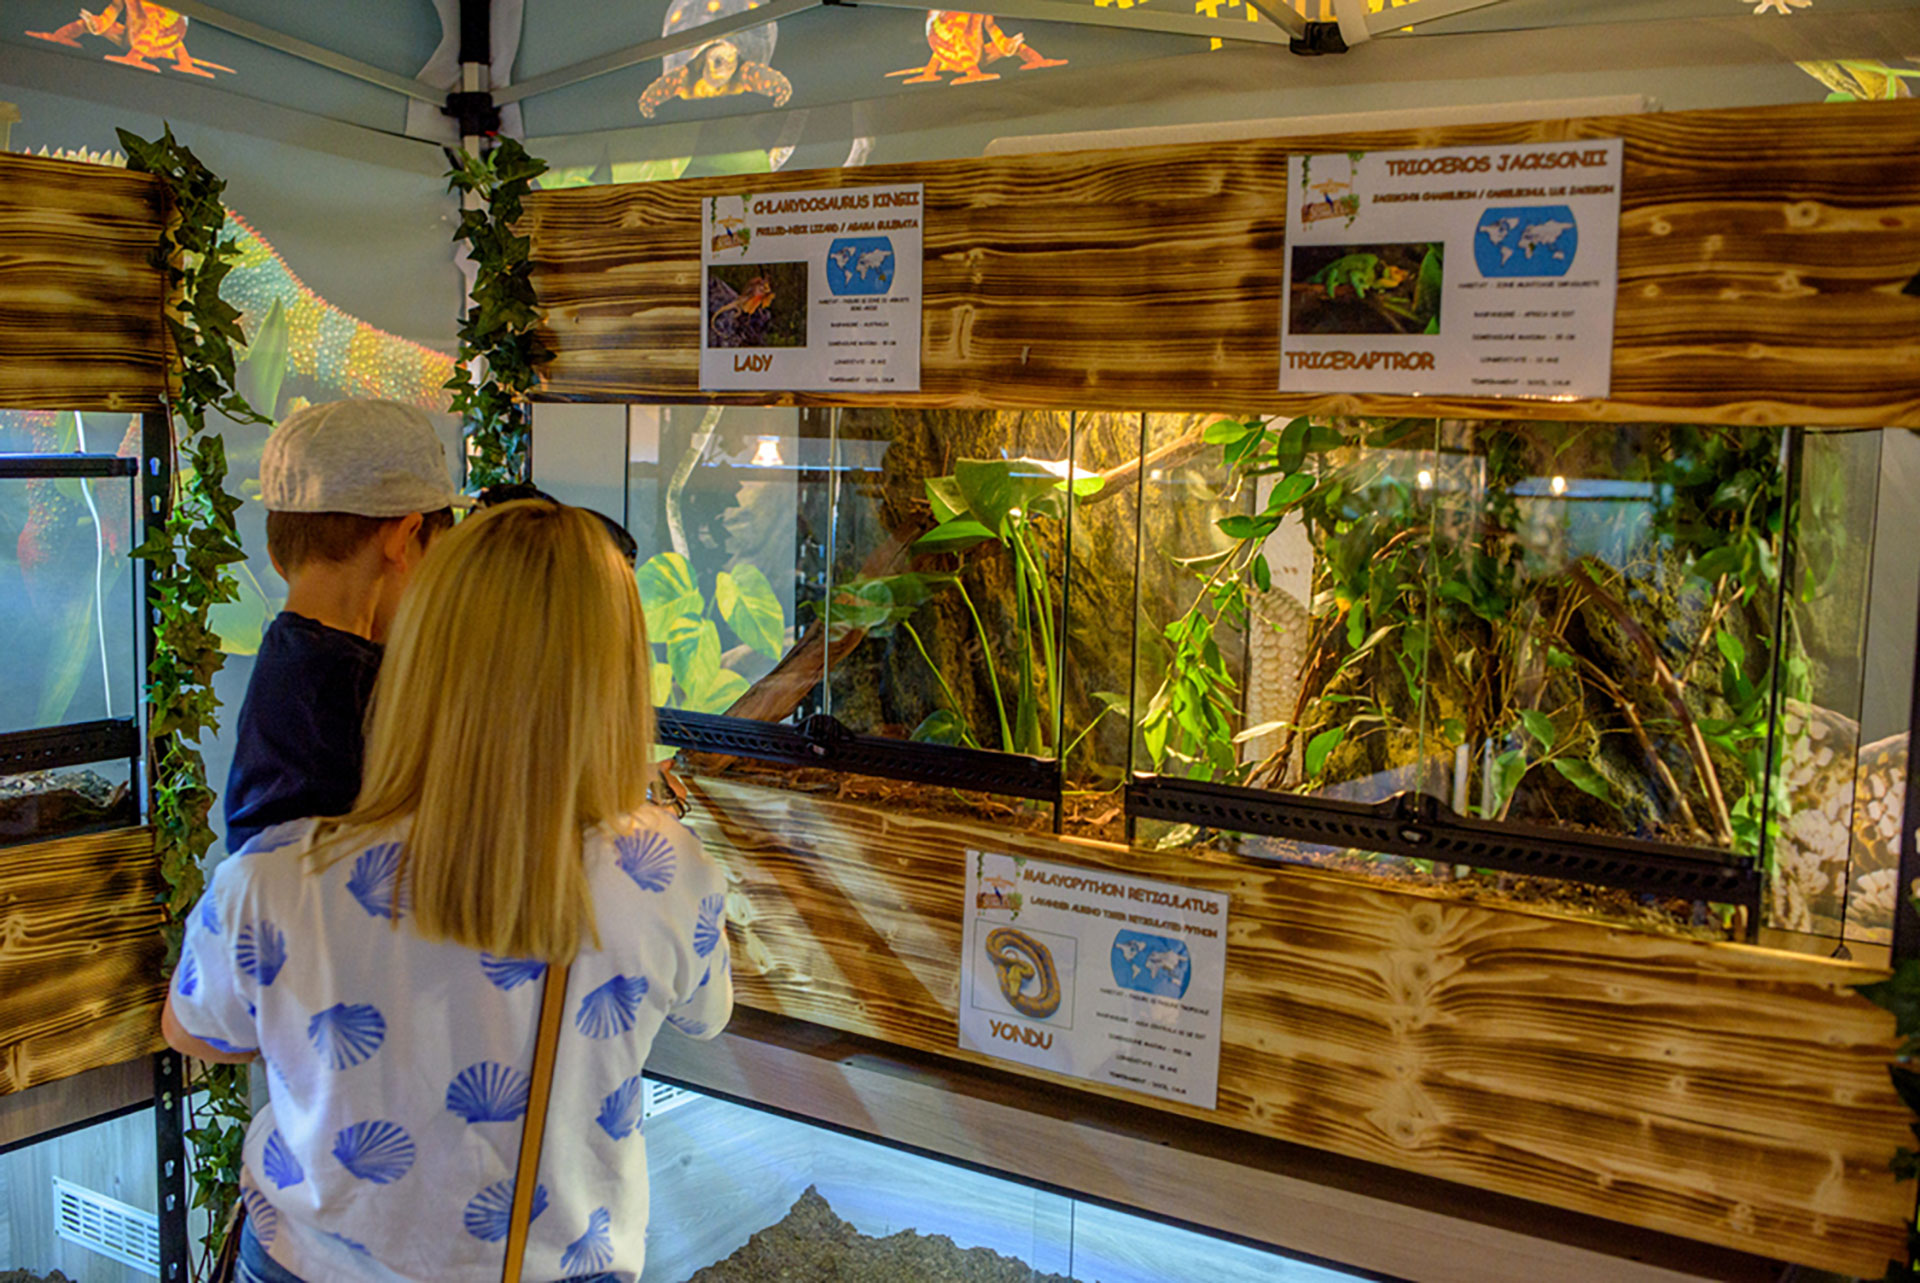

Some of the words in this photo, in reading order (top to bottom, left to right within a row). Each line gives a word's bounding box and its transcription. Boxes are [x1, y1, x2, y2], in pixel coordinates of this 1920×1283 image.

[1386, 156, 1490, 177] TRIOCEROS
[1497, 150, 1608, 172] JACKSONII
[753, 194, 869, 215] CHLAMYDOSAURUS
[734, 354, 773, 372] LADY
[1284, 350, 1436, 371] TRICERAPTROR
[1023, 868, 1125, 899] MALAYOPYTHON
[1128, 886, 1219, 916] RETICULATUS
[989, 1018, 1054, 1050] YONDU
